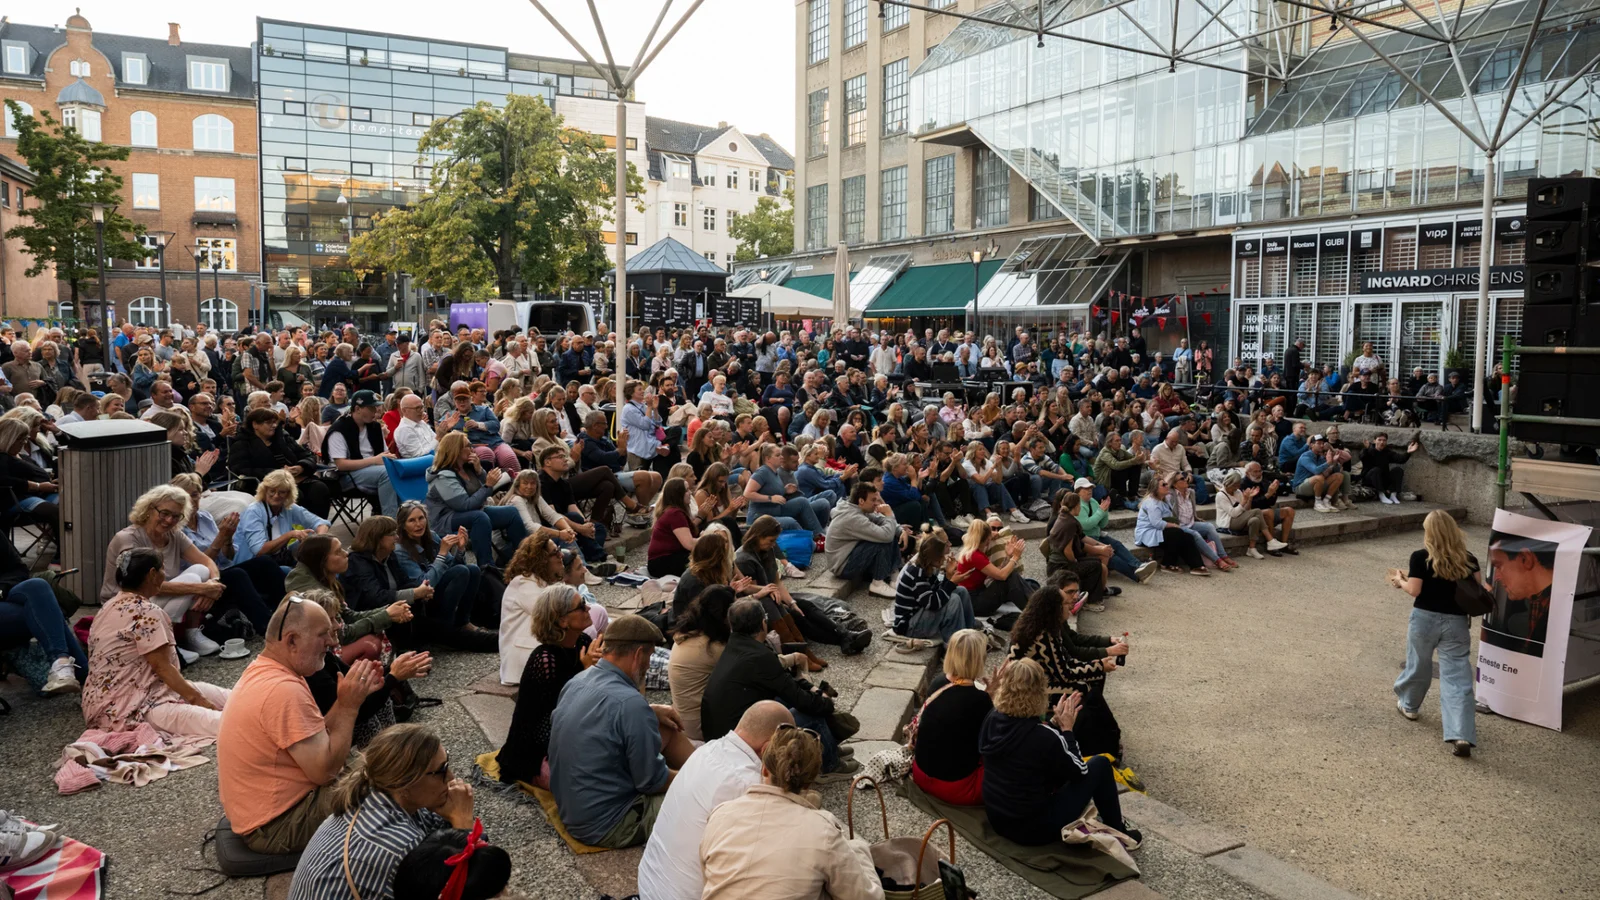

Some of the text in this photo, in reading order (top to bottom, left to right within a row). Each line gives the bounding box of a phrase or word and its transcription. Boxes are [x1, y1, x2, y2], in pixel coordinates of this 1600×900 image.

[352, 121, 423, 138] temp-tea
[1425, 229, 1448, 239] vipp
[1325, 238, 1345, 247] GUBI
[1241, 324, 1285, 333] FINN JUHL
[1241, 341, 1260, 351] louis
[1502, 663, 1519, 675] Ene
